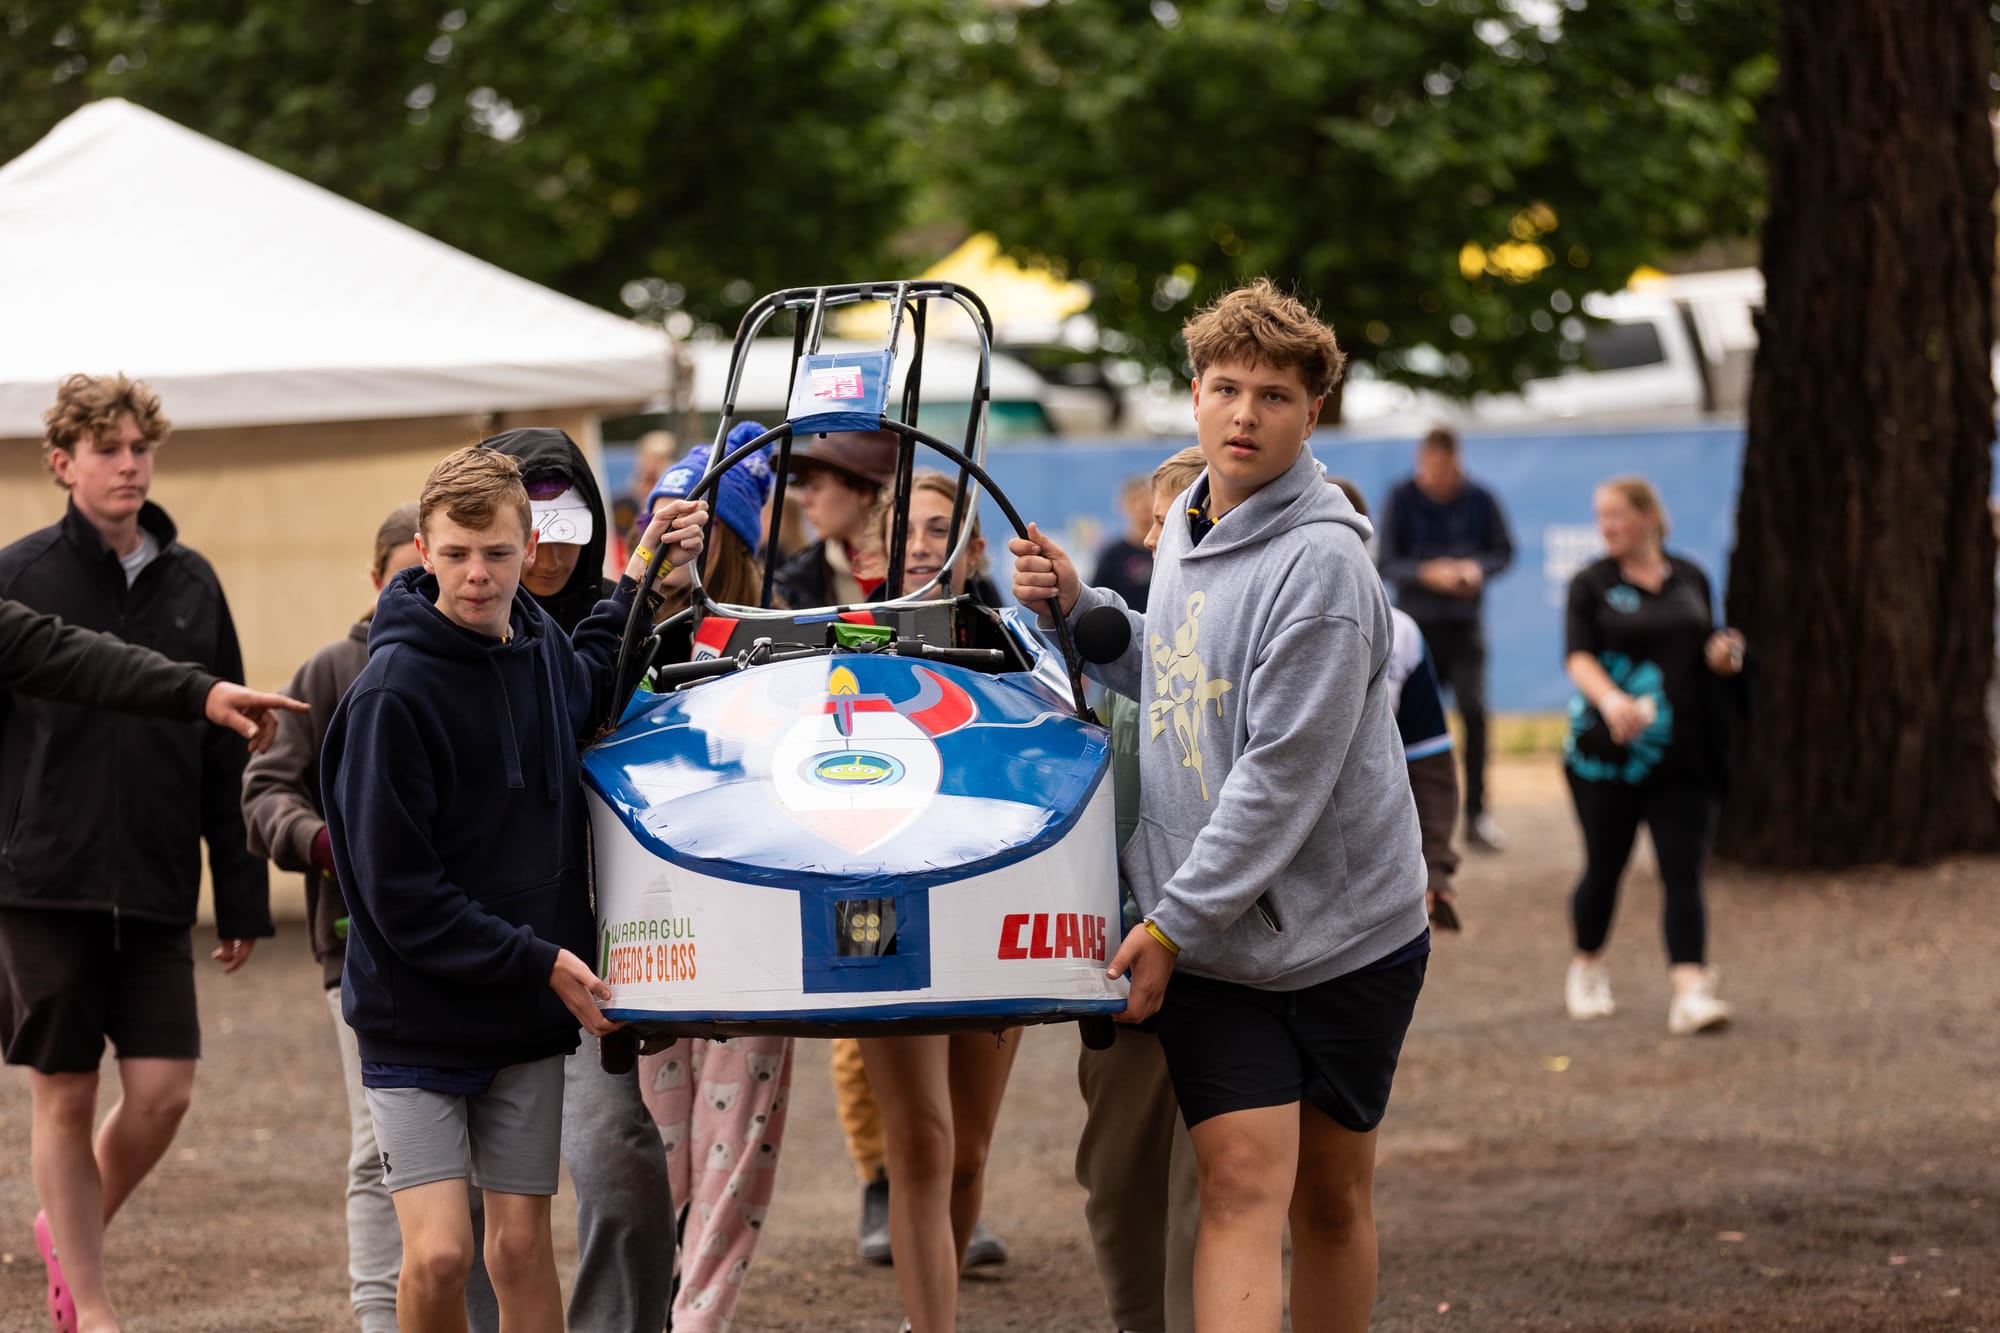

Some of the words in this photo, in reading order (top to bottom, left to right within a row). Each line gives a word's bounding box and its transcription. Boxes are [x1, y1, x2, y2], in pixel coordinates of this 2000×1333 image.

[611, 917, 695, 944] WARRAGUL
[997, 913, 1105, 961] CLAAS
[608, 946, 642, 985] SCREENS
[646, 945, 653, 982] &
[657, 943, 696, 981] GLASS
